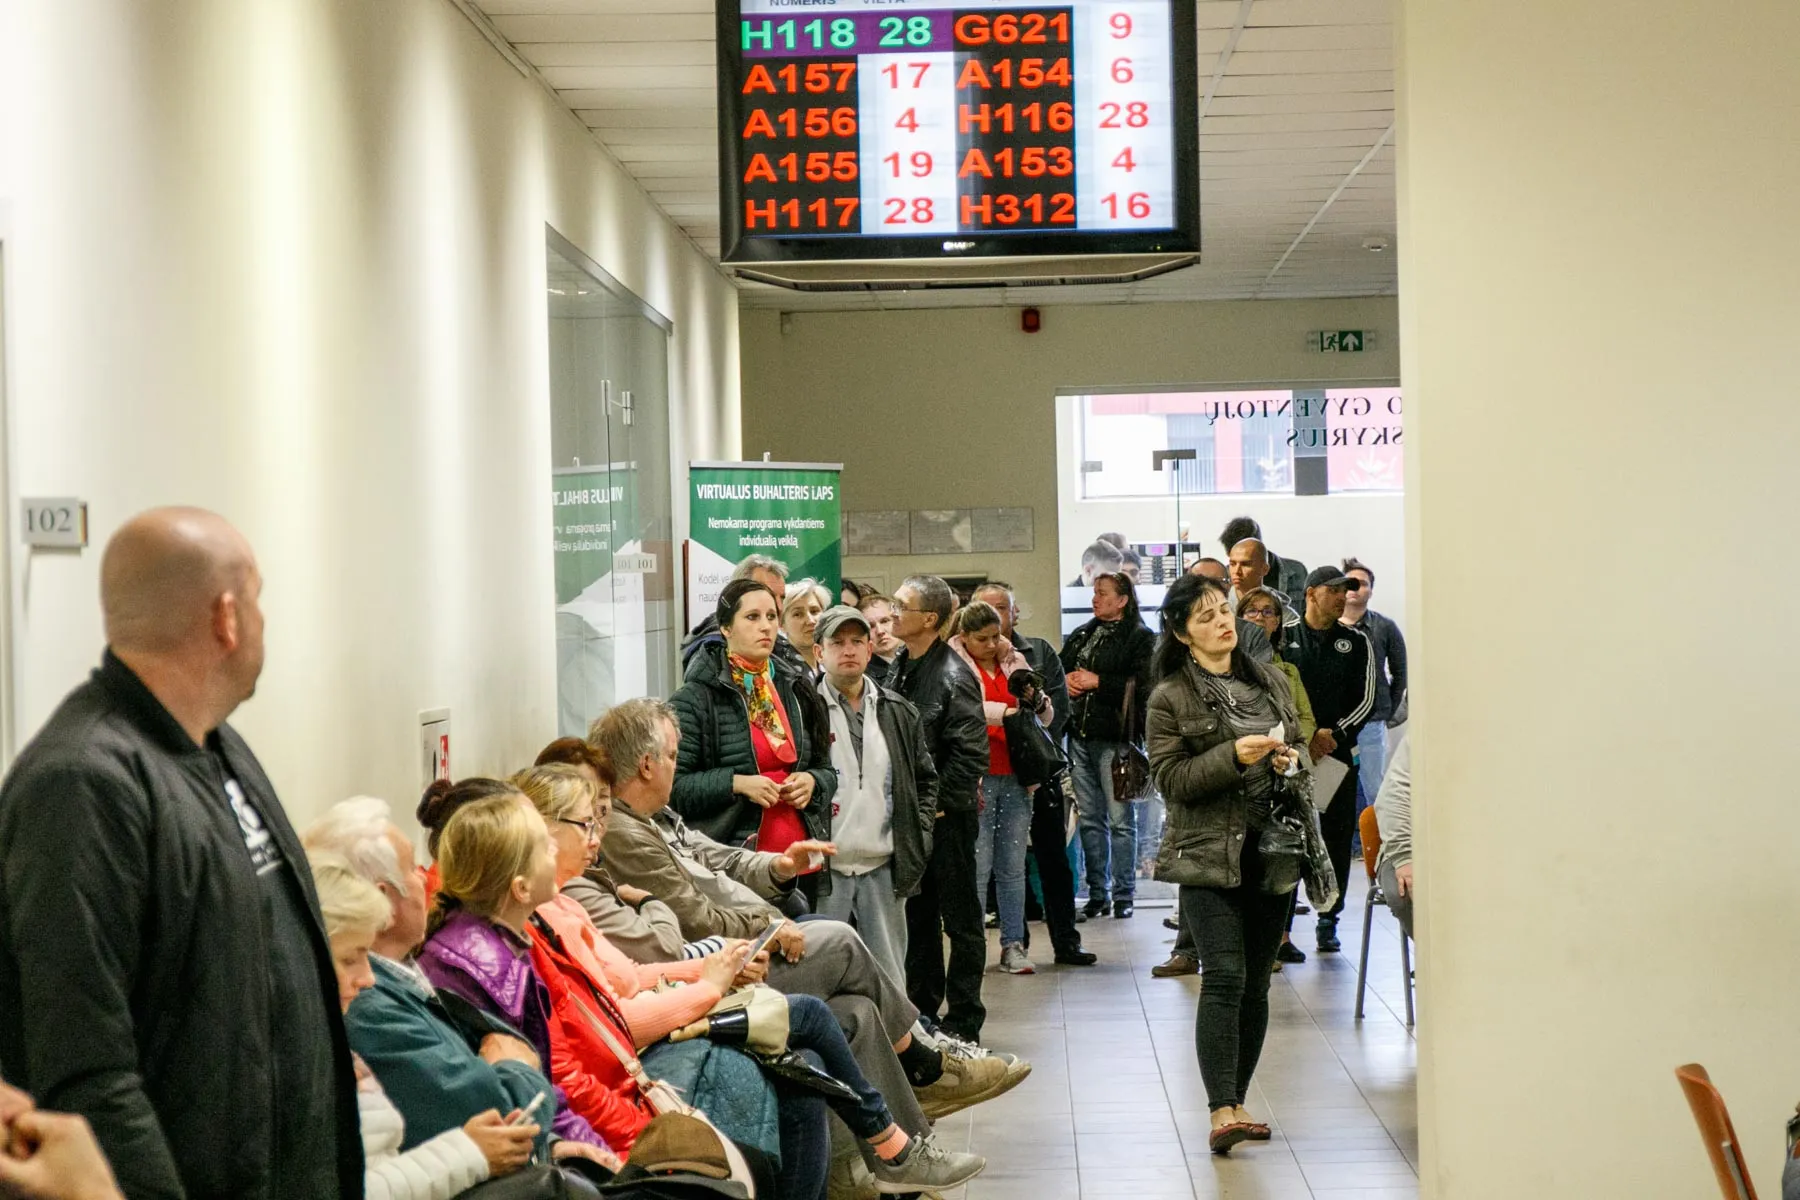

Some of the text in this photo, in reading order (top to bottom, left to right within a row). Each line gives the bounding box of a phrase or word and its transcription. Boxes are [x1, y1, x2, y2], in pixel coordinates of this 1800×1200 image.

[742, 16, 932, 50] H118 28
[954, 12, 1133, 45] G621 9
[743, 62, 931, 94] A157 17
[957, 57, 1134, 89] A154 6
[743, 107, 920, 138] A156 4
[960, 101, 1149, 133] H116 28
[744, 151, 934, 182] A155 19
[959, 146, 1137, 178] A153 4
[746, 197, 935, 228] H117 28
[961, 192, 1151, 224] H312 16
[696, 484, 751, 499] VIRTUALUS
[753, 484, 809, 500] BUHALTERIS
[27, 508, 72, 532] 102
[708, 517, 825, 531] Nemokama programa vykdantiems
[739, 535, 799, 549] individualią veiklą
[637, 559, 653, 569] 101
[698, 590, 720, 602] naud
